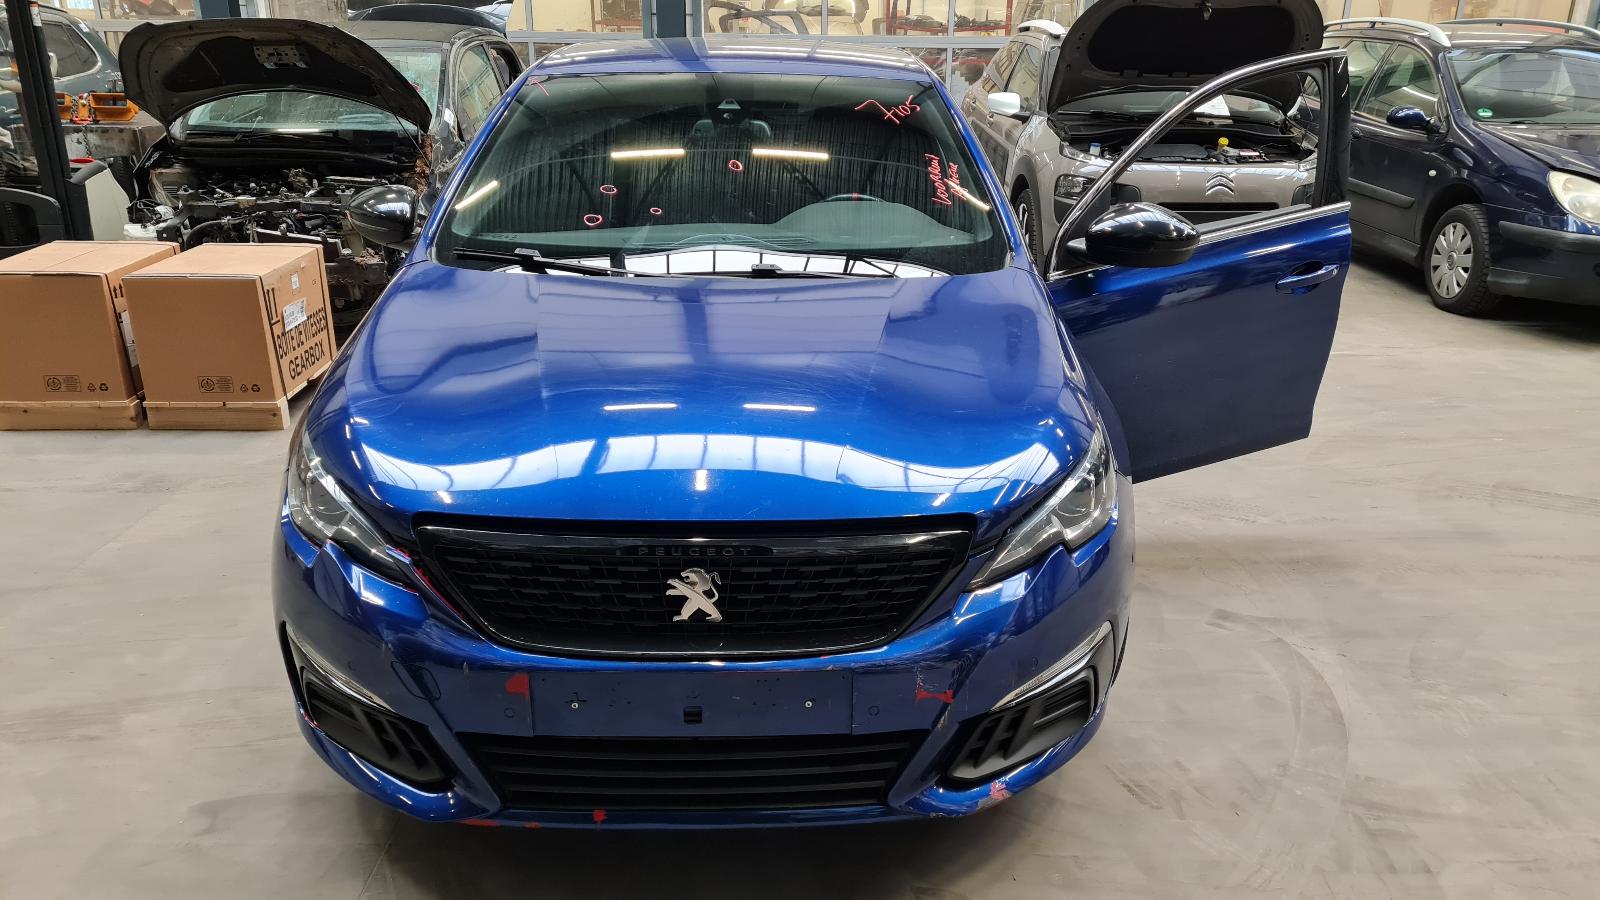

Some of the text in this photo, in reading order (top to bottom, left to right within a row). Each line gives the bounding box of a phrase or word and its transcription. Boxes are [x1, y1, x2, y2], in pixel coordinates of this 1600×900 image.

[302, 306, 328, 343] VITESSES
[288, 338, 326, 381] GEARBOX
[638, 544, 752, 556] PEUGEOT
